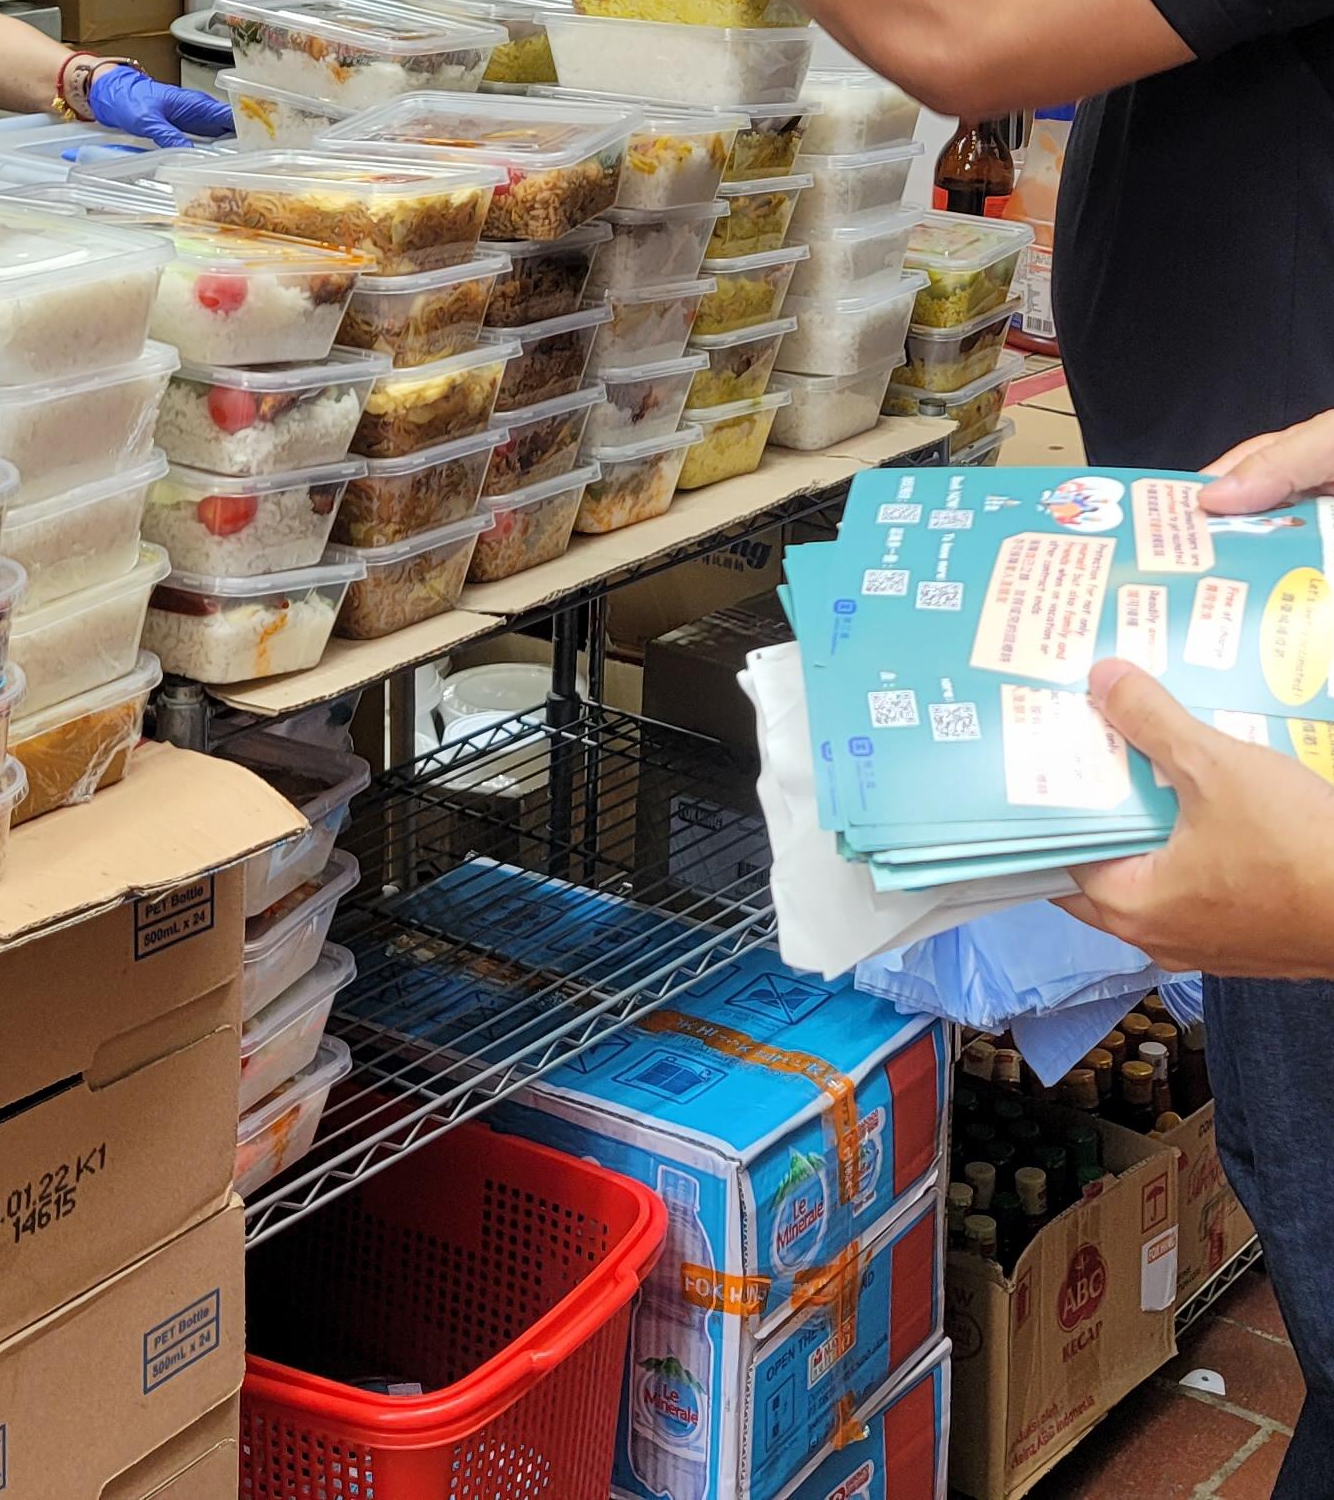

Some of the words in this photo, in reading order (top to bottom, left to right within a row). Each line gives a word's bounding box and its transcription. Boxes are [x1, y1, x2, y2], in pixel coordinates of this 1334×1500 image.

[1057, 567, 1068, 588] when
[1088, 543, 1109, 583] Protection
[1031, 594, 1043, 616] ends
[1084, 600, 1096, 616] not
[1146, 589, 1161, 625] Readily
[1225, 585, 1240, 610] Free
[1042, 600, 1060, 642] vacation
[1059, 609, 1077, 639] family
[1075, 617, 1089, 637] only
[1039, 644, 1049, 656] or
[1054, 641, 1067, 661] and
[170, 885, 204, 908] Bottle
[144, 921, 180, 947] 500mL
[182, 919, 190, 929] x
[192, 909, 206, 926] 24
[75, 1142, 107, 1184] K1
[13, 1185, 78, 1244] 14615
[792, 1197, 807, 1218] Le
[776, 1200, 825, 1253] Minerale
[1062, 1267, 1105, 1323] ABC
[153, 1328, 175, 1350] PET
[178, 1305, 210, 1335] Bottle
[1062, 1320, 1104, 1364] KECAP
[152, 1348, 186, 1379] 500mL
[189, 1342, 196, 1352] x
[199, 1329, 212, 1348] 24
[767, 1357, 797, 1382] OPEN
[643, 1390, 699, 1425] Minerale
[662, 1383, 680, 1402] Le
